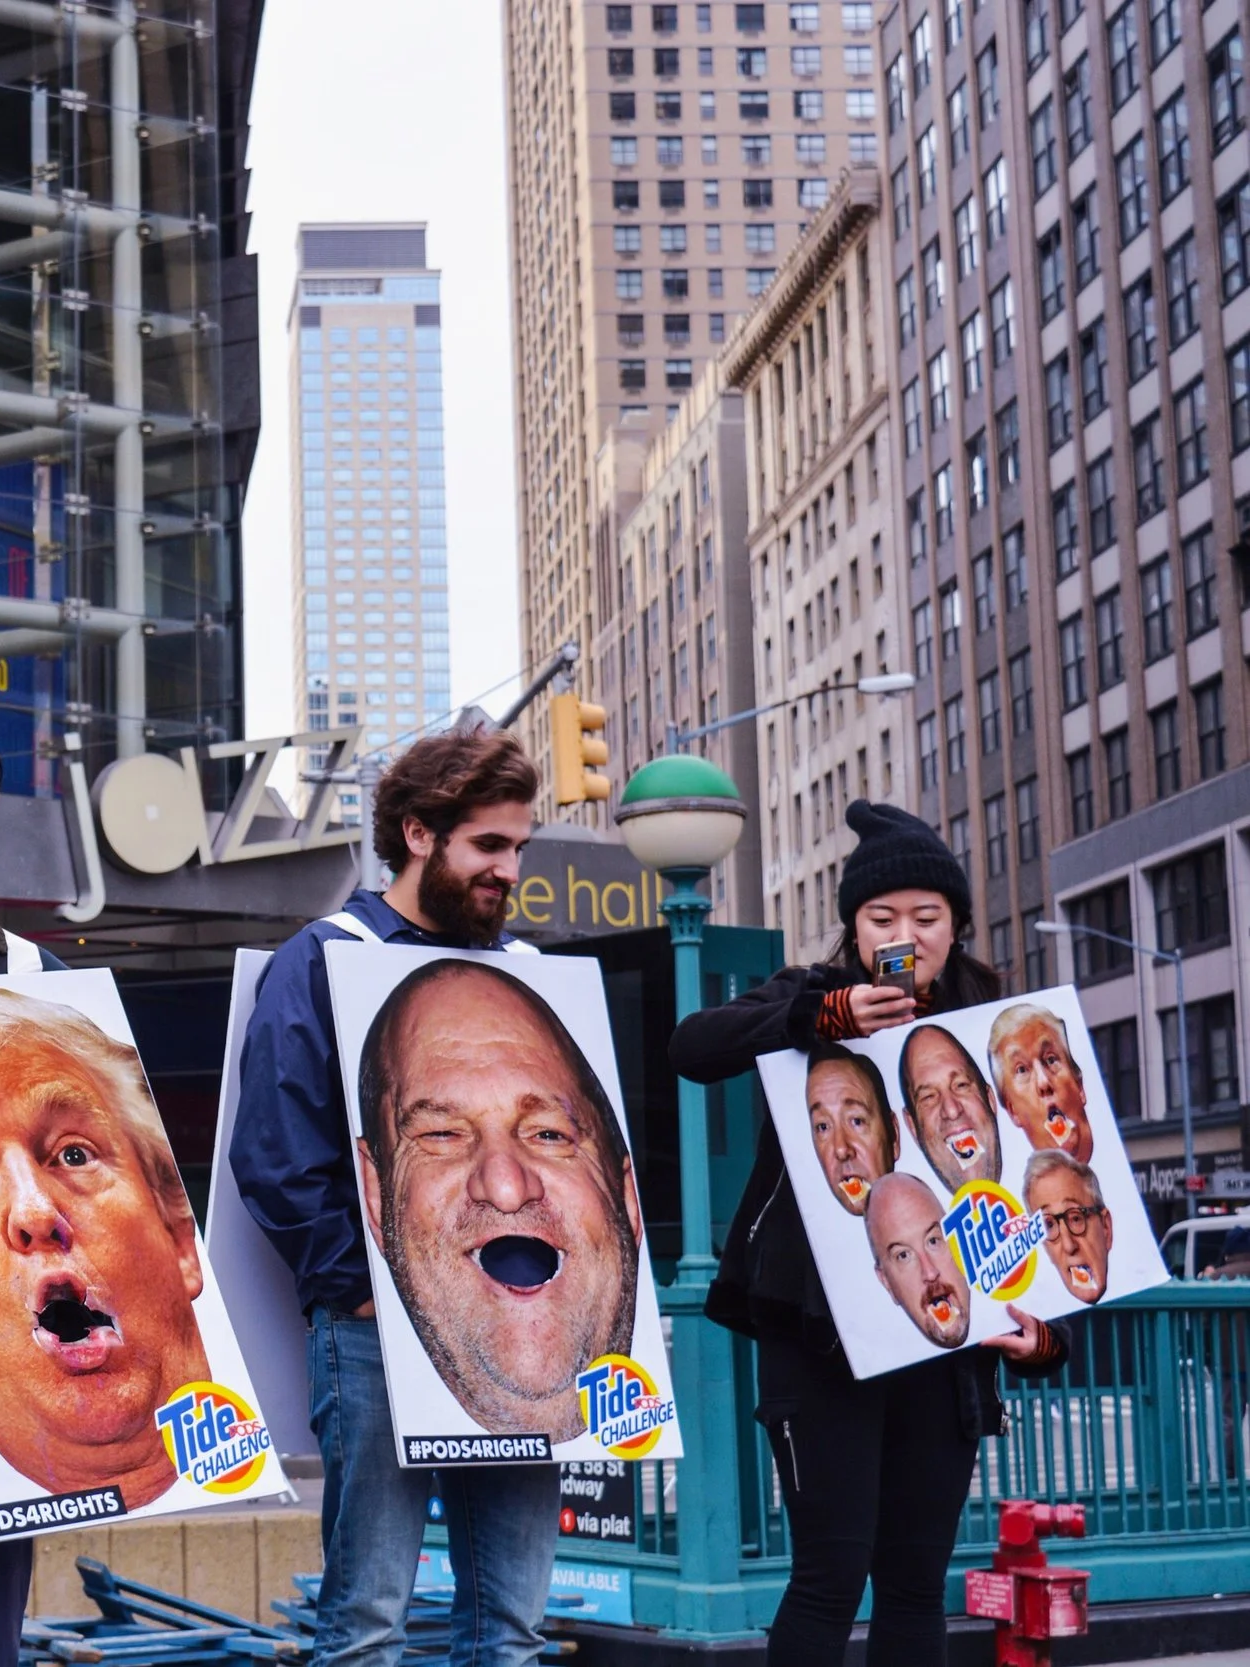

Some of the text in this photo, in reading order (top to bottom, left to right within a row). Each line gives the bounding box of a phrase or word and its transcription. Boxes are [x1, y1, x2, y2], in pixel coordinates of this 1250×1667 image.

[58, 724, 364, 923] jazz
[567, 864, 664, 927] hall
[942, 1197, 1007, 1286] Tide
[980, 1214, 1045, 1294] CHALLENGE
[578, 1365, 641, 1435] Tide
[601, 1401, 674, 1447] CHALLENGE
[157, 1394, 235, 1474] Tide
[409, 1438, 547, 1460] #PODS4RIGHTS
[430, 1500, 441, 1516] A
[576, 1511, 599, 1533] via
[601, 1513, 631, 1538] plat
[551, 1567, 621, 1593] AVAILABLE
